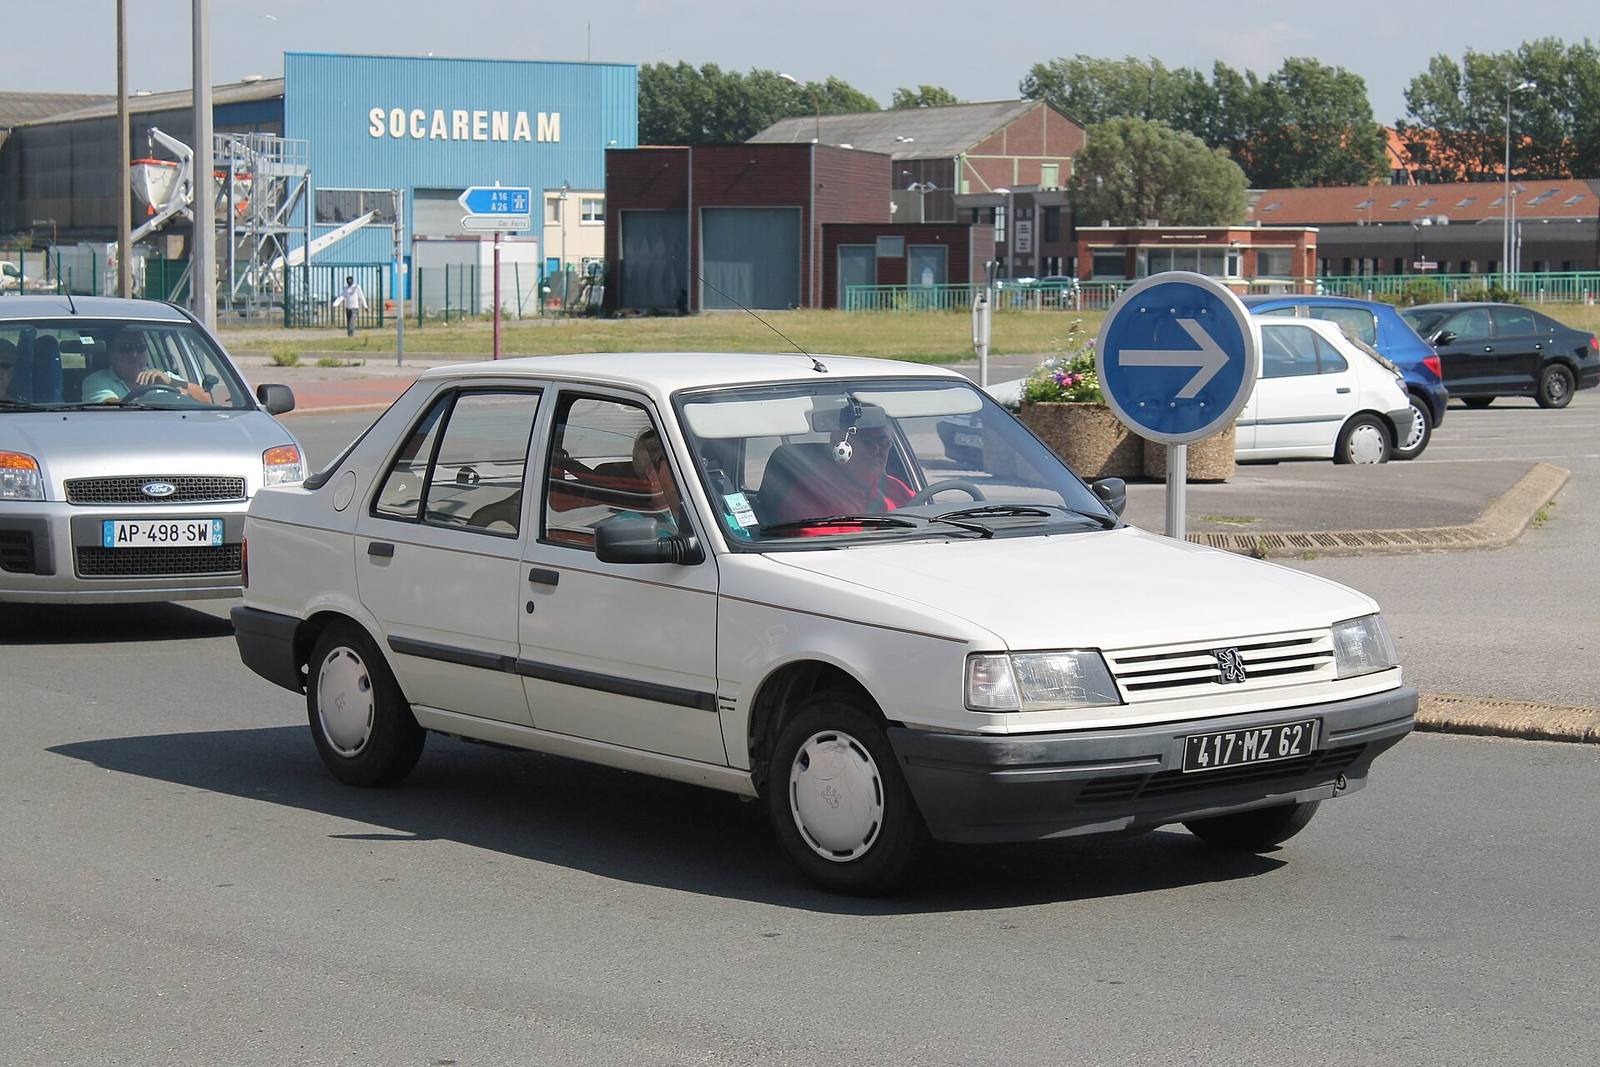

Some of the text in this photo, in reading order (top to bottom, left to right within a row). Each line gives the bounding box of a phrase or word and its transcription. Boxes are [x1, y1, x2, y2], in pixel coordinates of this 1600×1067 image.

[369, 107, 561, 143] SOCARENAM
[150, 485, 168, 493] Ford
[117, 523, 208, 542] AP-498-SW
[212, 534, 222, 544] 62
[1197, 725, 1303, 766] 417 MZ 62
